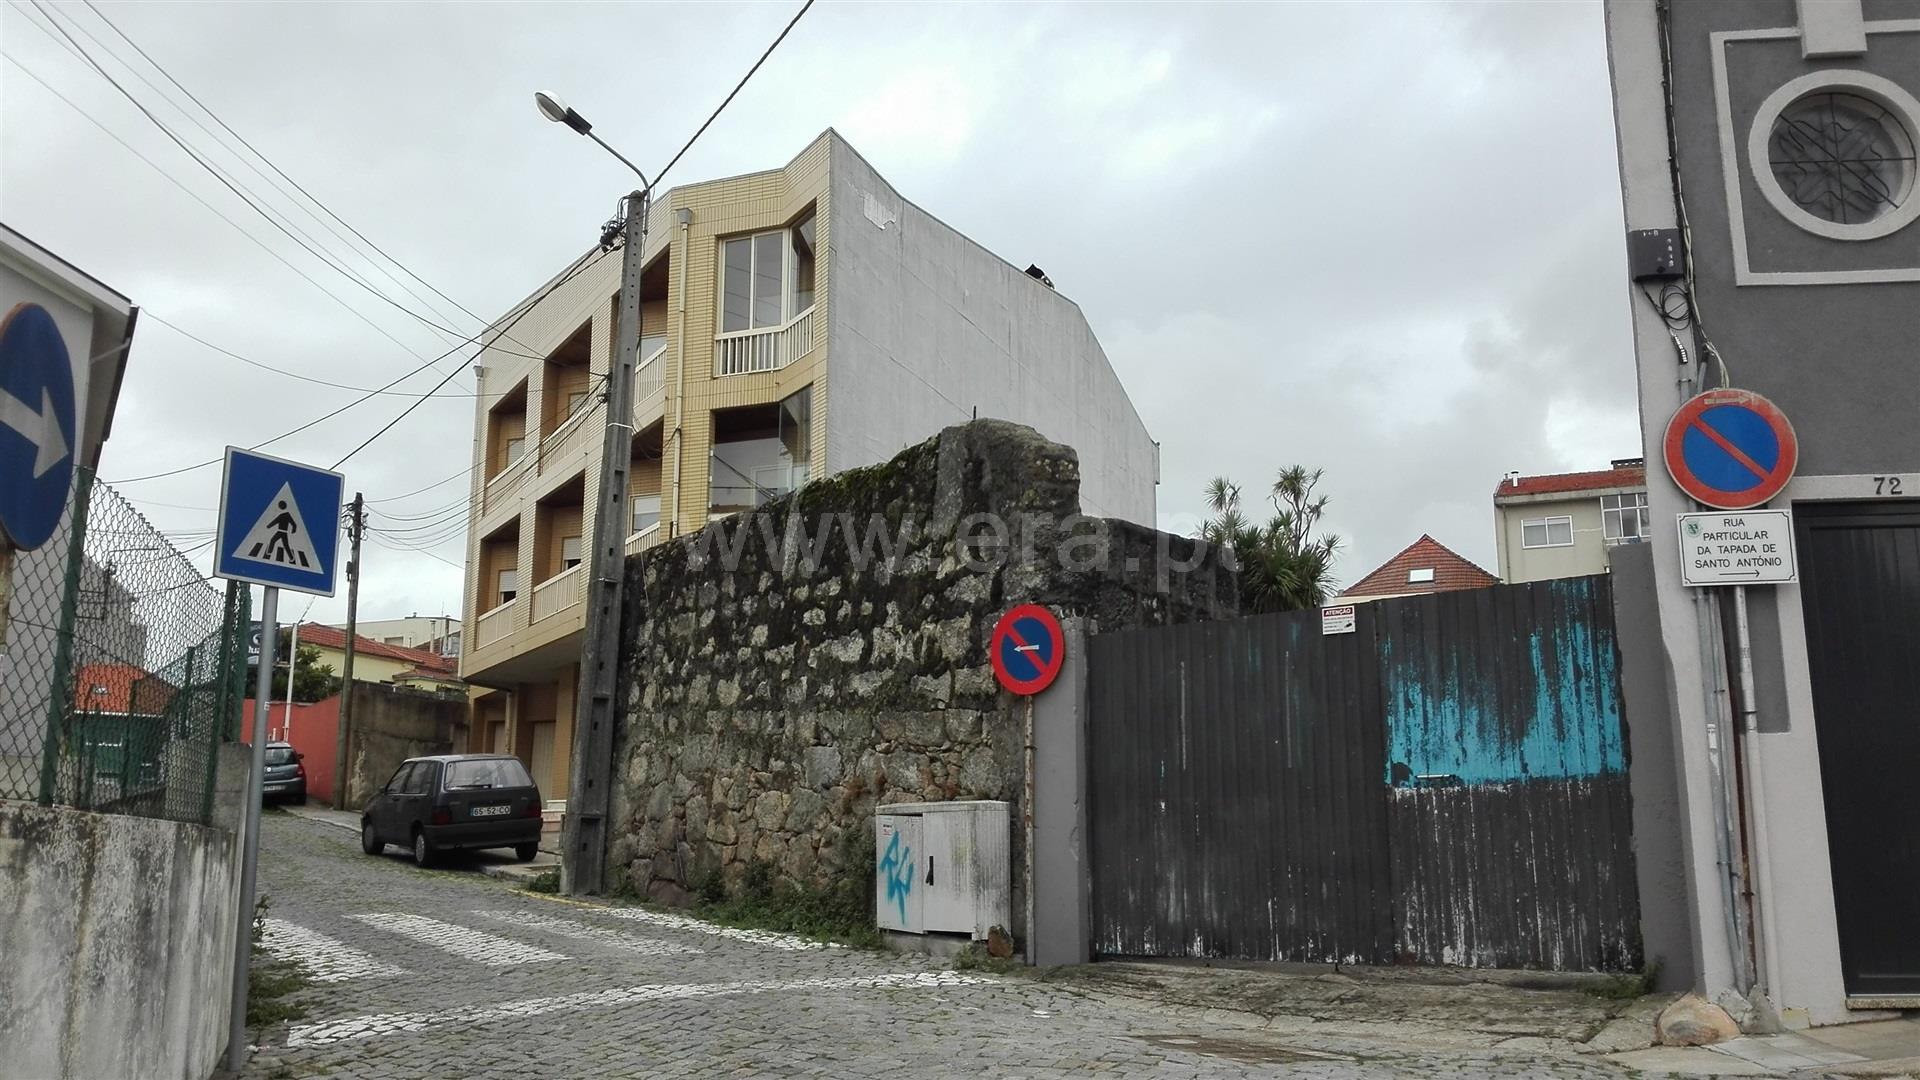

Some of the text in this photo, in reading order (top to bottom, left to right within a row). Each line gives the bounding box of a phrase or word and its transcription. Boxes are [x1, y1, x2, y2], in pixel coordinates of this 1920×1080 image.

[1873, 477, 1902, 495] 72
[1723, 518, 1745, 527] RUA
[1703, 530, 1769, 541] PARTICULAR
[1697, 543, 1777, 555] DA TAPADA DE
[1695, 555, 1782, 568] SANTO ANTÓNIO
